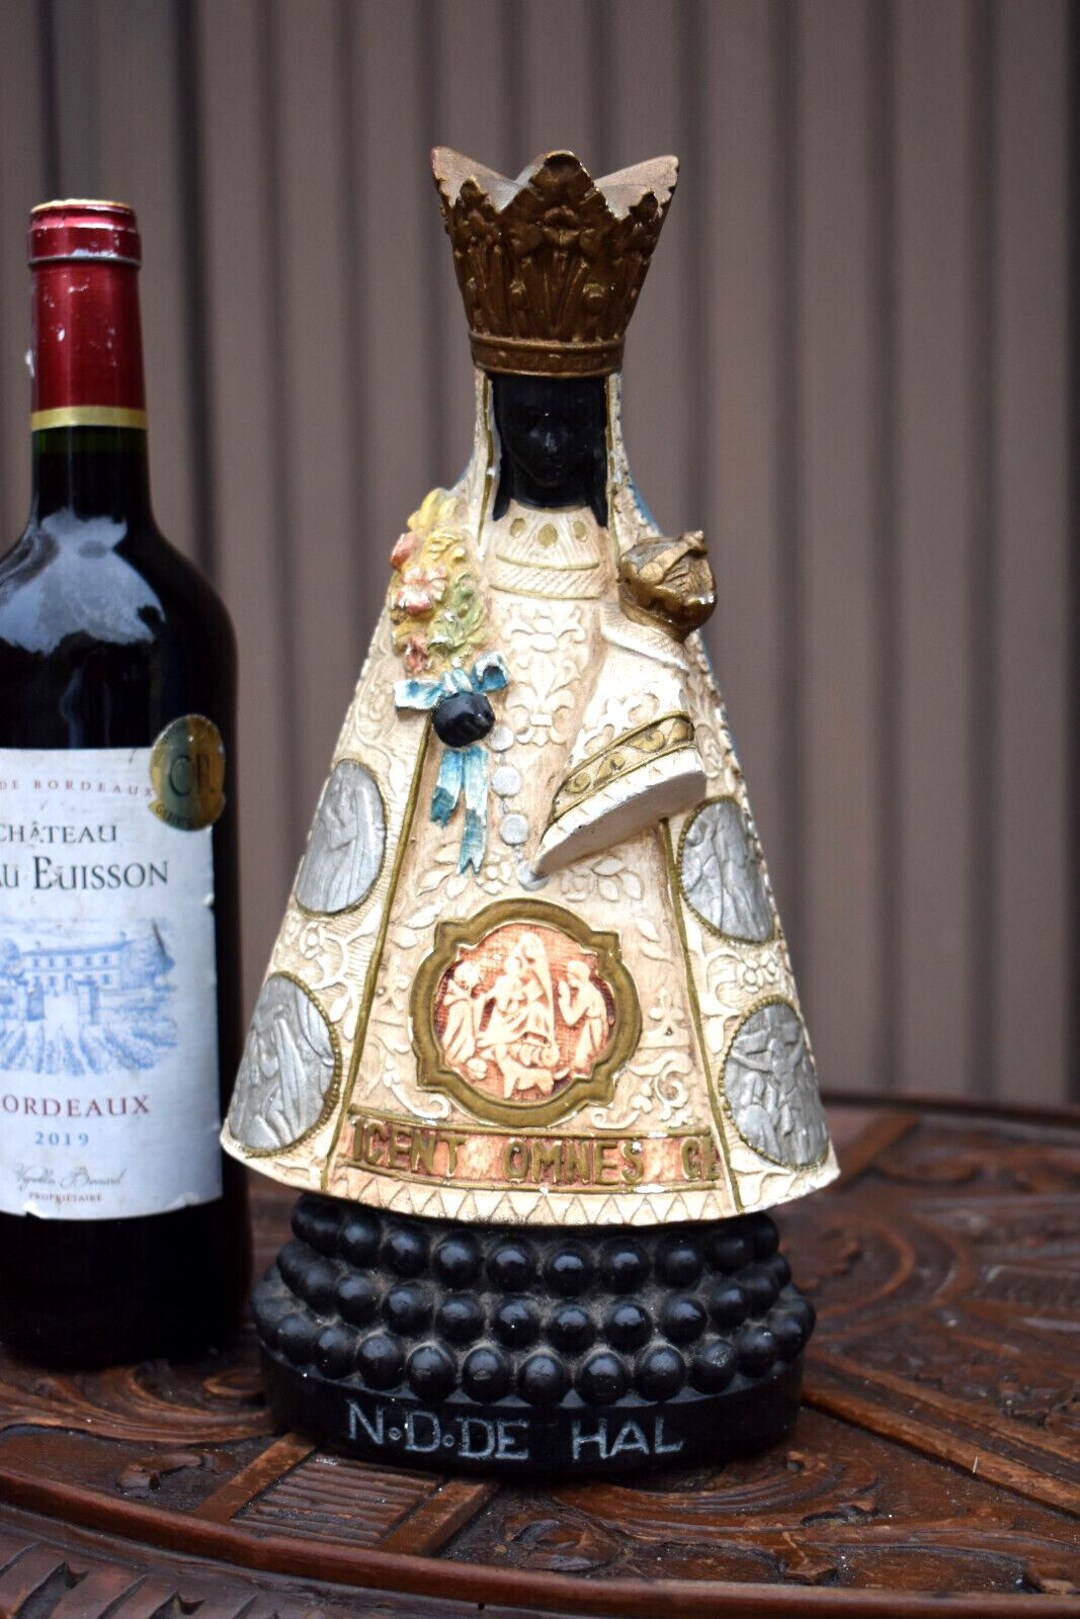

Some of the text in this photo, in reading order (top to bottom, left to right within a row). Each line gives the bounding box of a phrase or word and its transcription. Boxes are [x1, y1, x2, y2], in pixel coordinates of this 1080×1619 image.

[33, 779, 153, 799] BORDEAUX
[0, 863, 19, 889] U
[34, 1131, 89, 1146] 2019
[503, 1137, 645, 1185] OMNES
[571, 1415, 684, 1459] HAL
